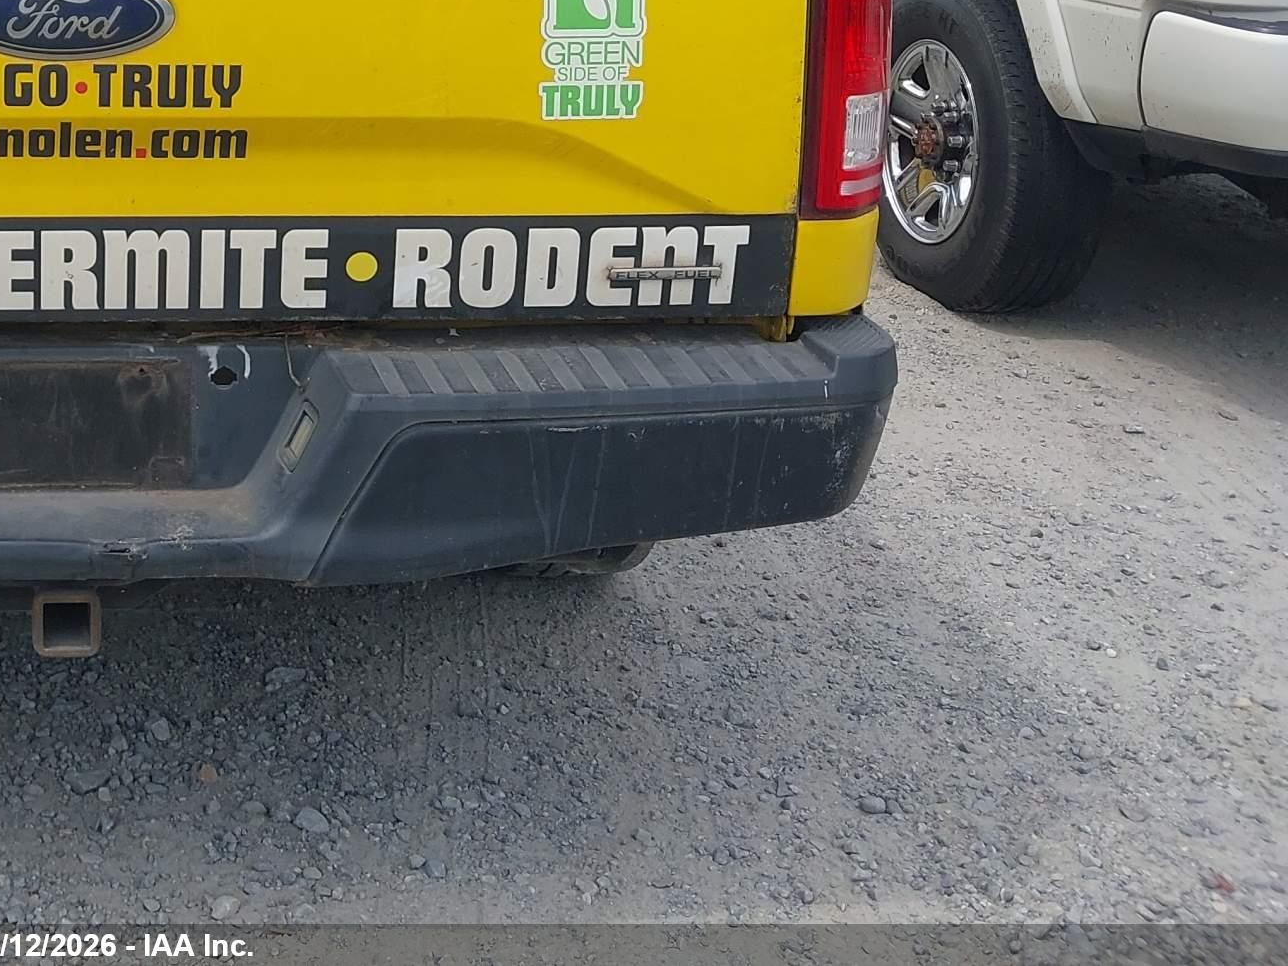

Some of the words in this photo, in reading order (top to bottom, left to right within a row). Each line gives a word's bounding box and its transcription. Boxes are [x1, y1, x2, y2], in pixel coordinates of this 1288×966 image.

[545, 40, 641, 66] GREEN
[557, 66, 599, 82] SIDE
[602, 66, 628, 82] OF
[542, 84, 641, 117] TRULY
[392, 225, 751, 310] RODENT
[615, 270, 660, 281] FLEX
[673, 269, 719, 280] FUEL
